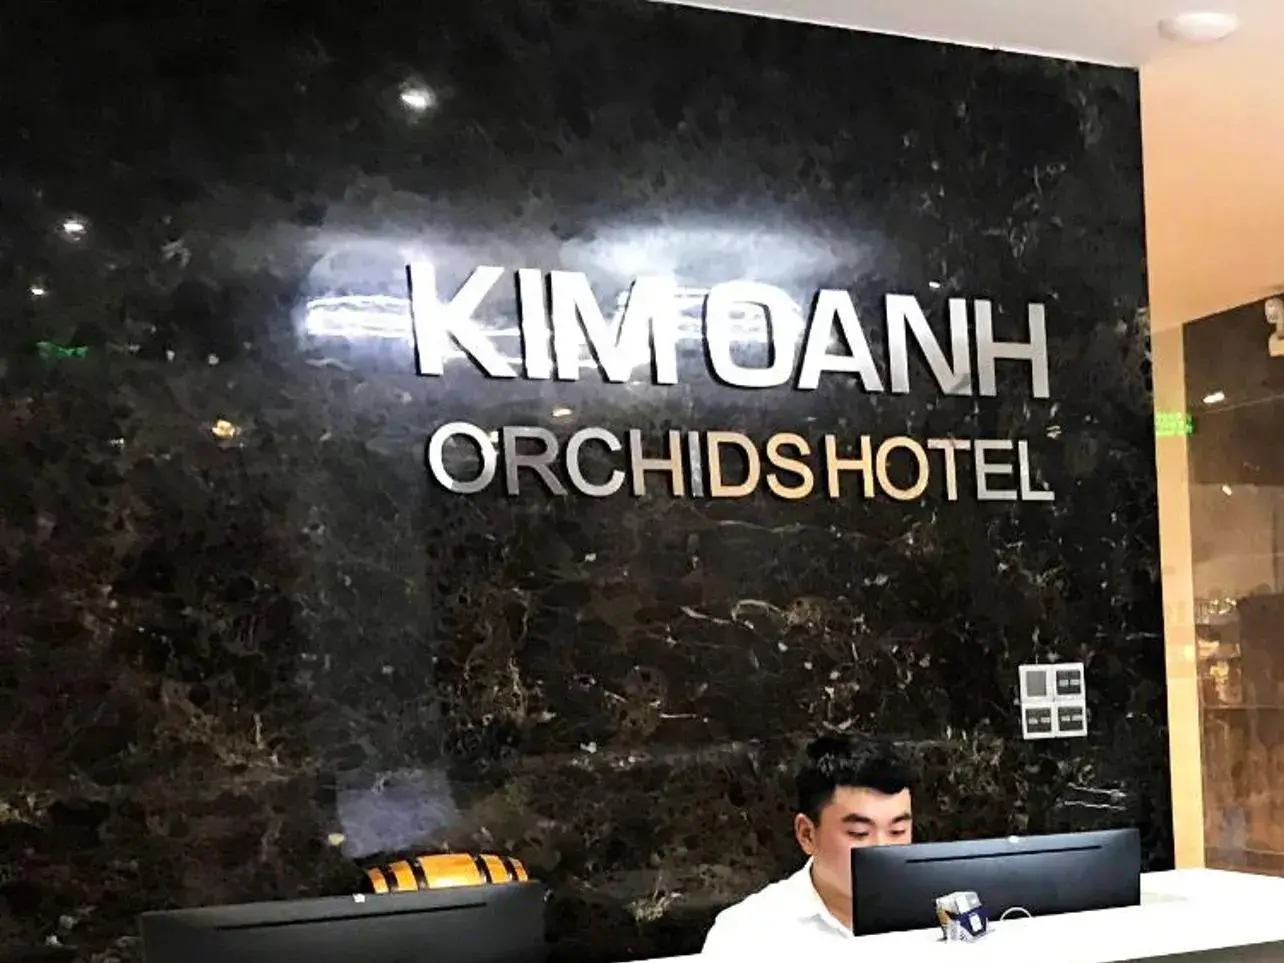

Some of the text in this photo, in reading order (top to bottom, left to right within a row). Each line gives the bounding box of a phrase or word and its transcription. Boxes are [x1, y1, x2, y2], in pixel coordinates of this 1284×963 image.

[407, 263, 1051, 398] KIM OANH
[427, 421, 1055, 500] ORCHIDS HOTEL
